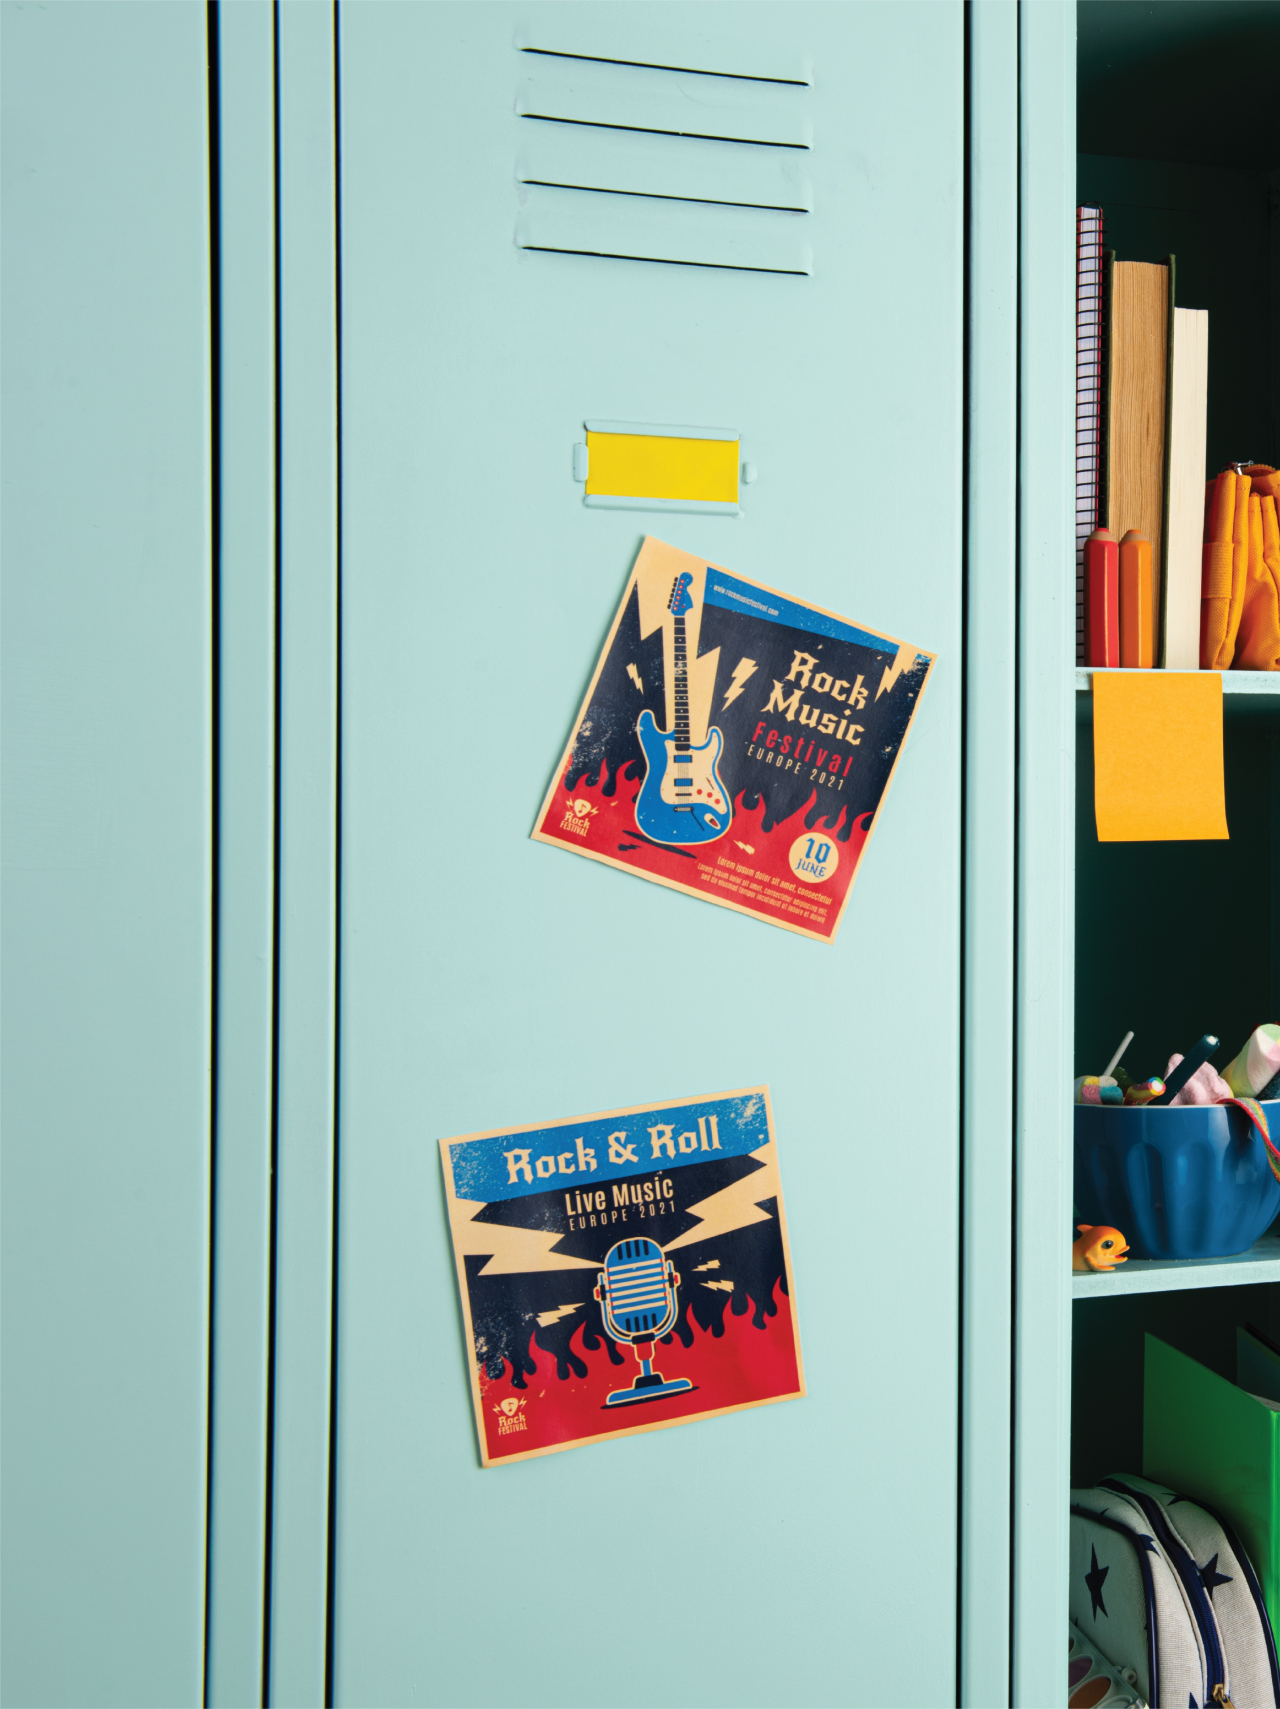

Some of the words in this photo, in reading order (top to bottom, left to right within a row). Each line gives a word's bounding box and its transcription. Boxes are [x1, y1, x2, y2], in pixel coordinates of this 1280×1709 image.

[784, 650, 869, 710] Rock
[760, 679, 865, 745] Music
[752, 721, 853, 777] Festival
[747, 744, 801, 774] EUROPE
[809, 769, 844, 790] 2021
[559, 820, 587, 837] FESTIVAL
[564, 811, 590, 828] Rock
[806, 837, 831, 864] 10
[697, 862, 713, 874] Lorem
[717, 856, 736, 870] Lorem
[735, 863, 755, 877] ipsum
[755, 870, 771, 882] dolor
[771, 877, 781, 886] sit
[780, 880, 796, 893] amet,
[794, 858, 827, 878] JUNE
[502, 1136, 598, 1185] Rock
[607, 1131, 639, 1164] &
[647, 1114, 723, 1160] Roll
[565, 1189, 606, 1216] Live
[612, 1177, 674, 1208] Music
[569, 1209, 628, 1231] EUROPE
[640, 1200, 675, 1218] 2021
[498, 1411, 526, 1427] Rock
[498, 1421, 528, 1436] FESTIVAL
